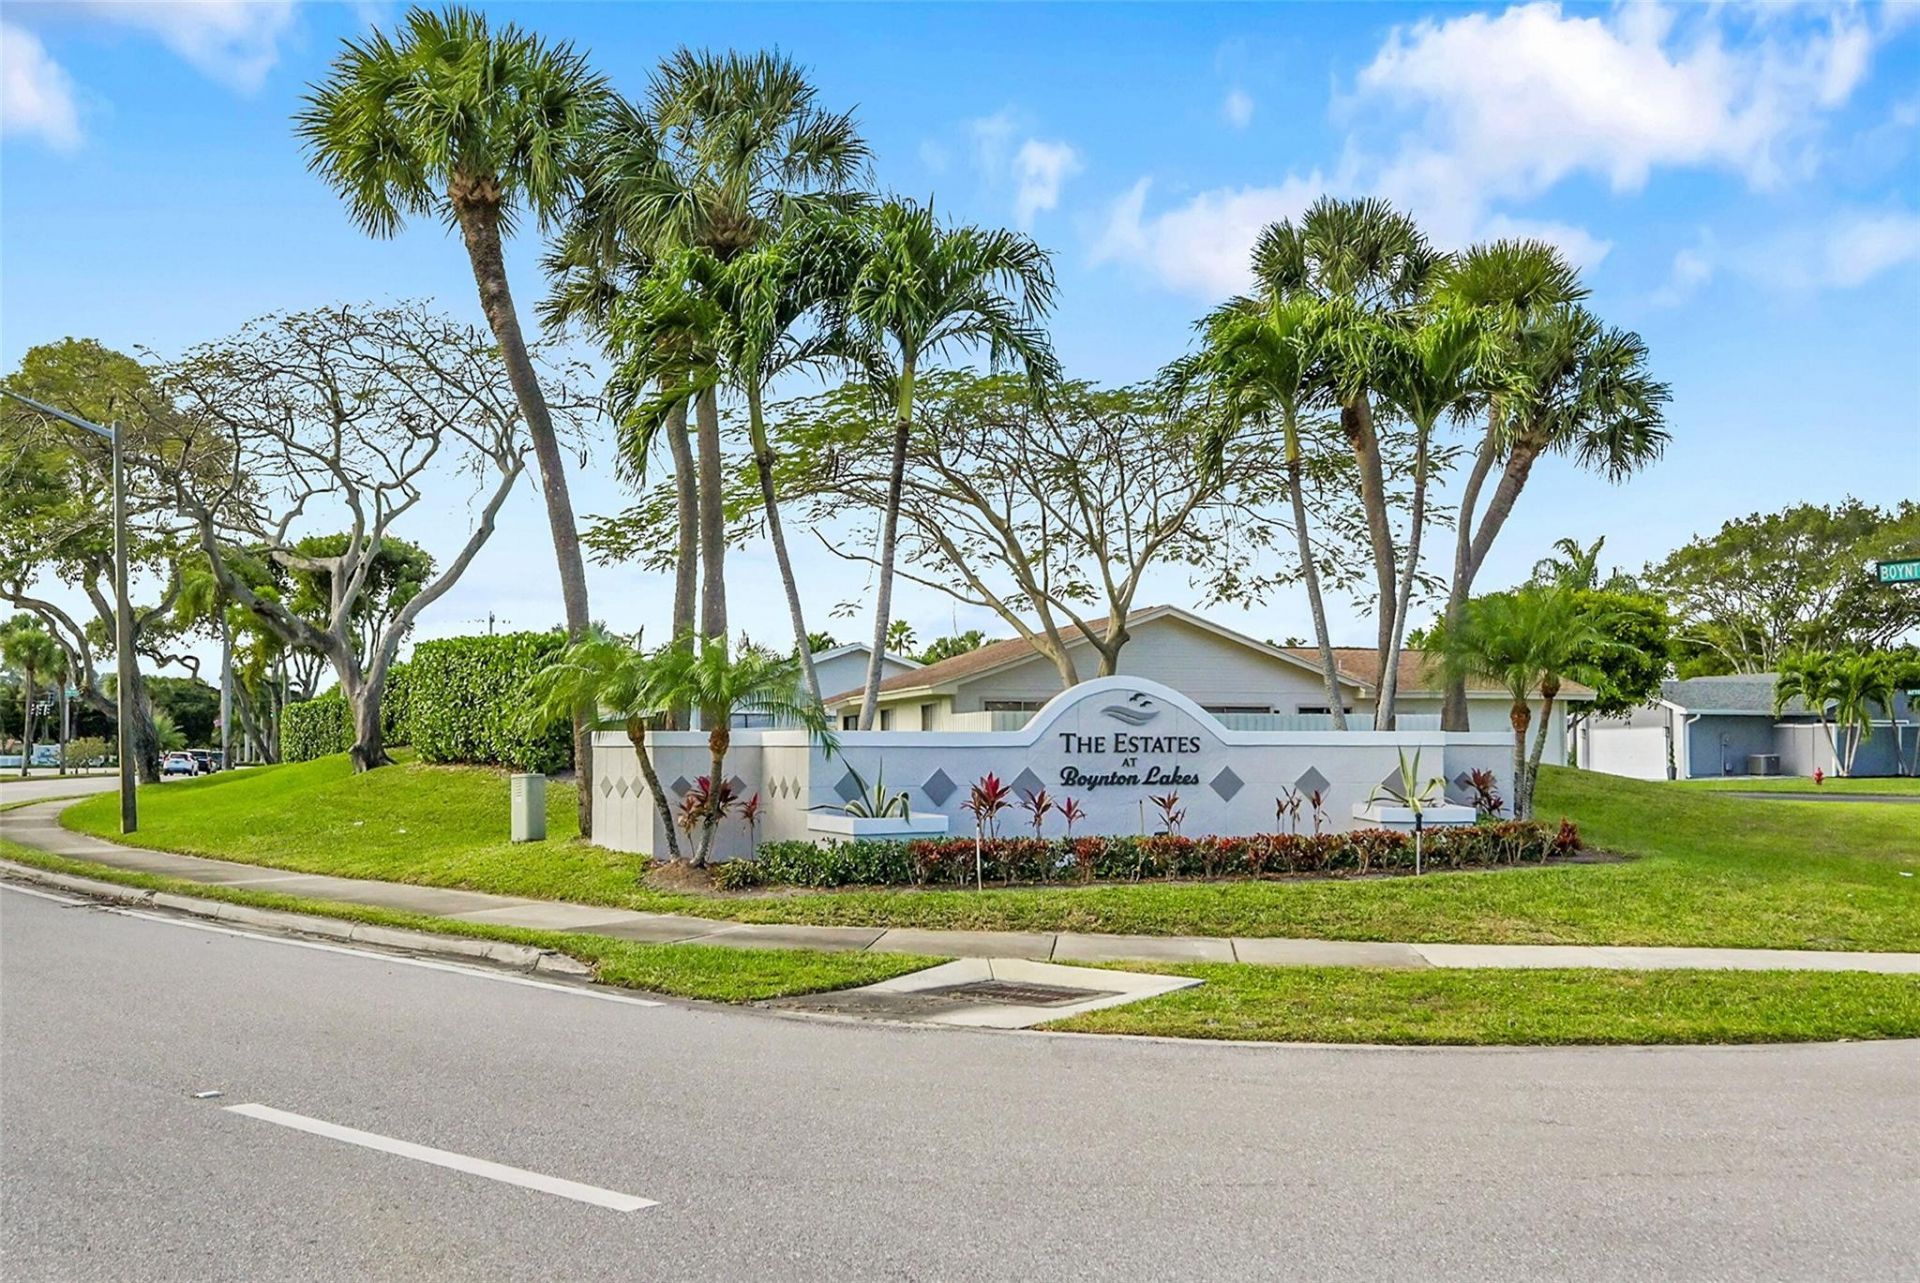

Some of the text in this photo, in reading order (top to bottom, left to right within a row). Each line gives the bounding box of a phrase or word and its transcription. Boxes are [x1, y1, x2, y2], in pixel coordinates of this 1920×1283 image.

[1059, 733, 1200, 753] THE ESTATES
[1122, 758, 1137, 767] AT
[1060, 765, 1199, 791] Boynton Lakes
